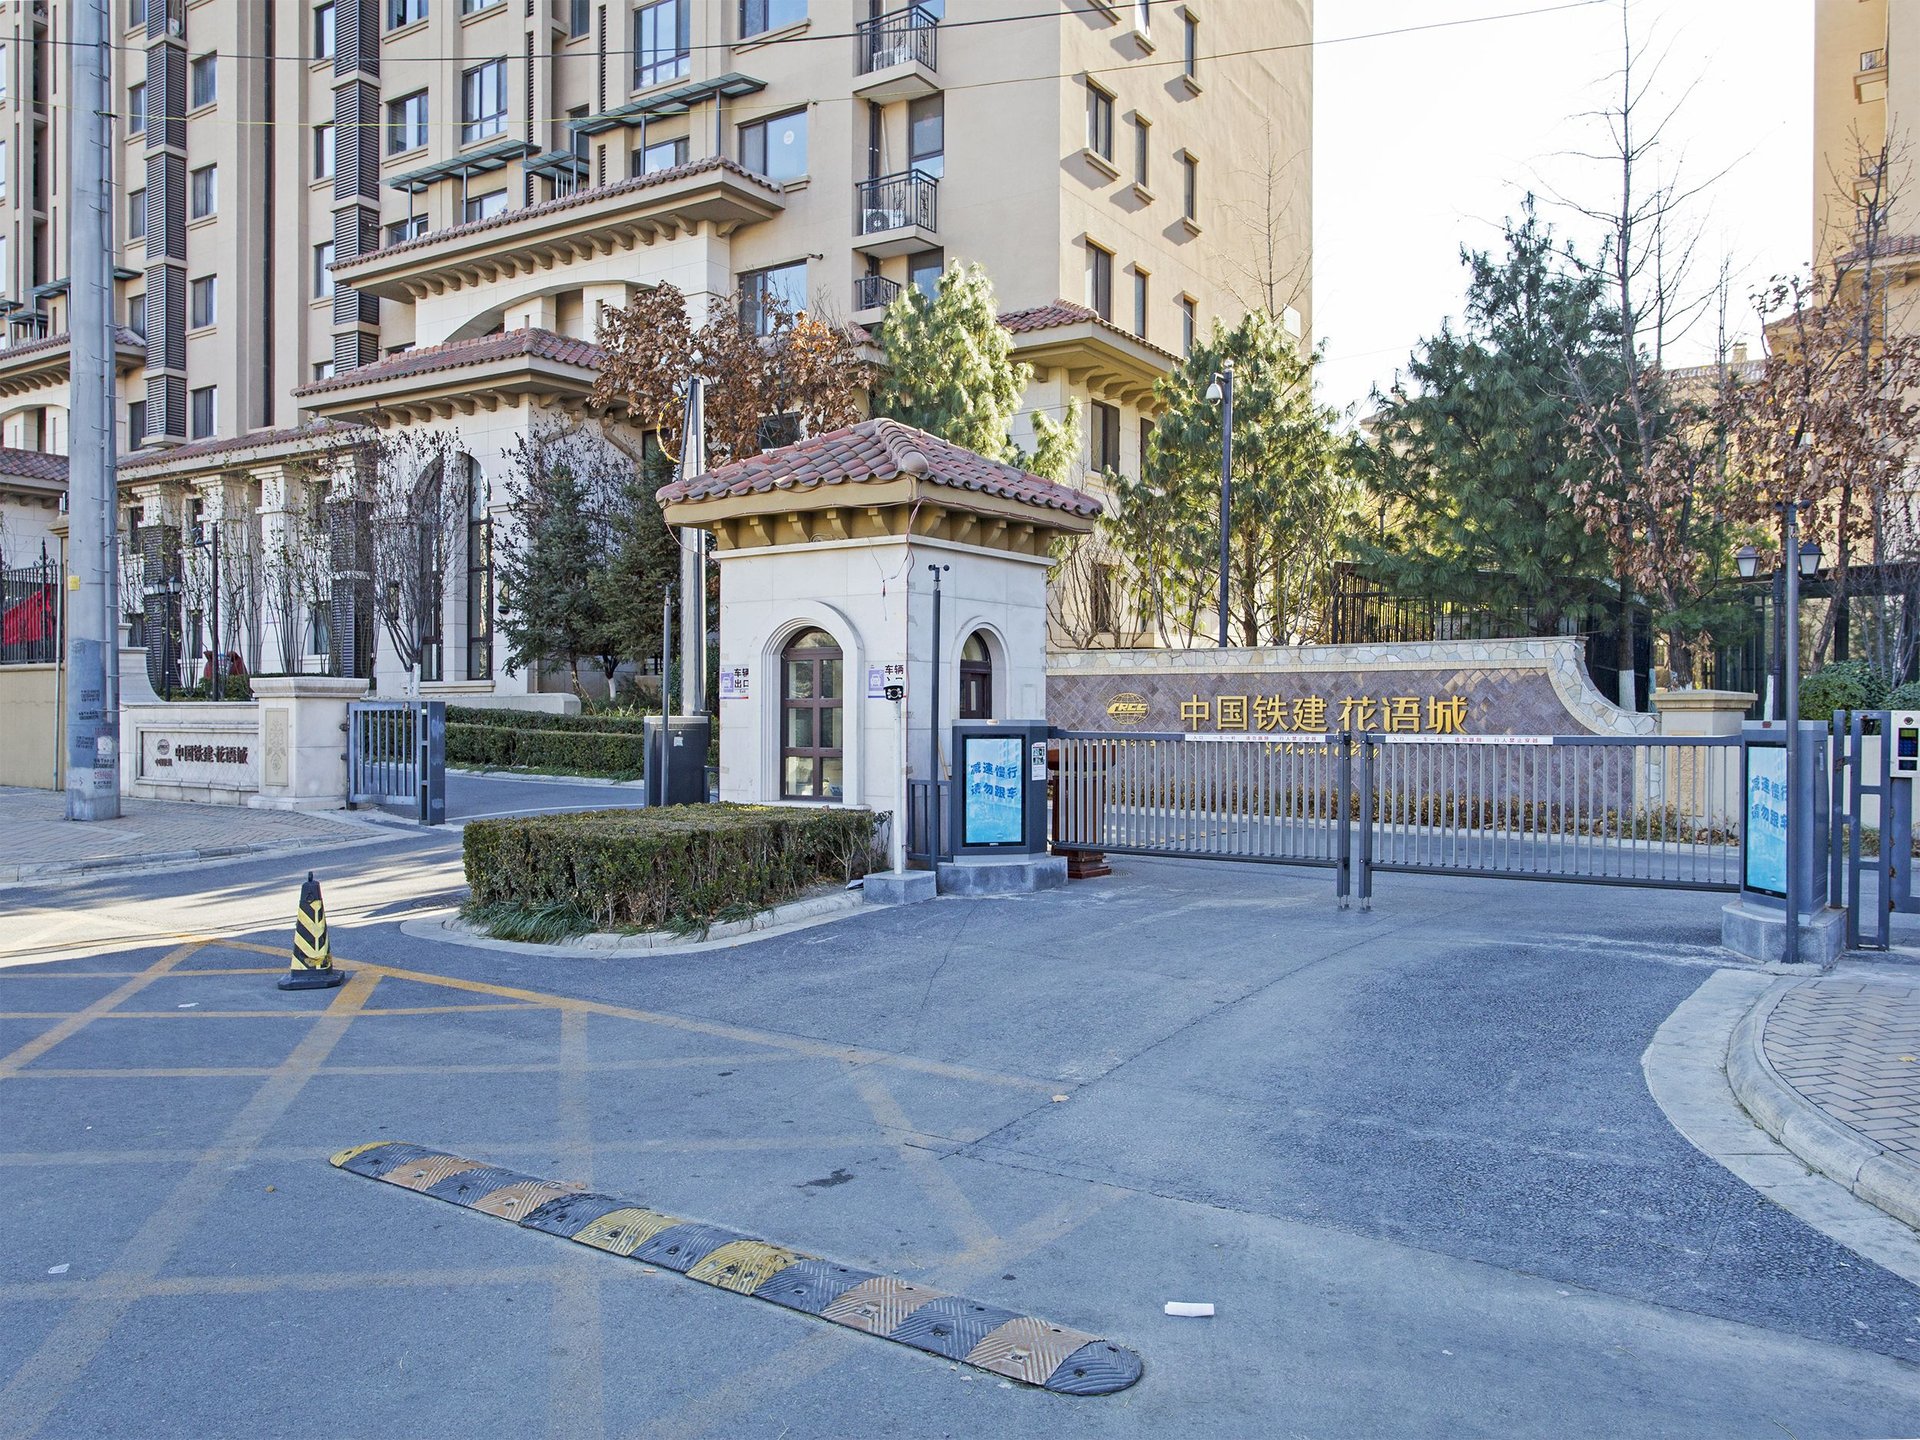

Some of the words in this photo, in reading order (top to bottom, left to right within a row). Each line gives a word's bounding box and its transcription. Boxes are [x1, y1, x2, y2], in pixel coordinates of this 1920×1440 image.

[884, 664, 904, 675] 车辆
[970, 762, 1018, 779] 减速慢行
[971, 782, 1018, 799] 请勿跟车
